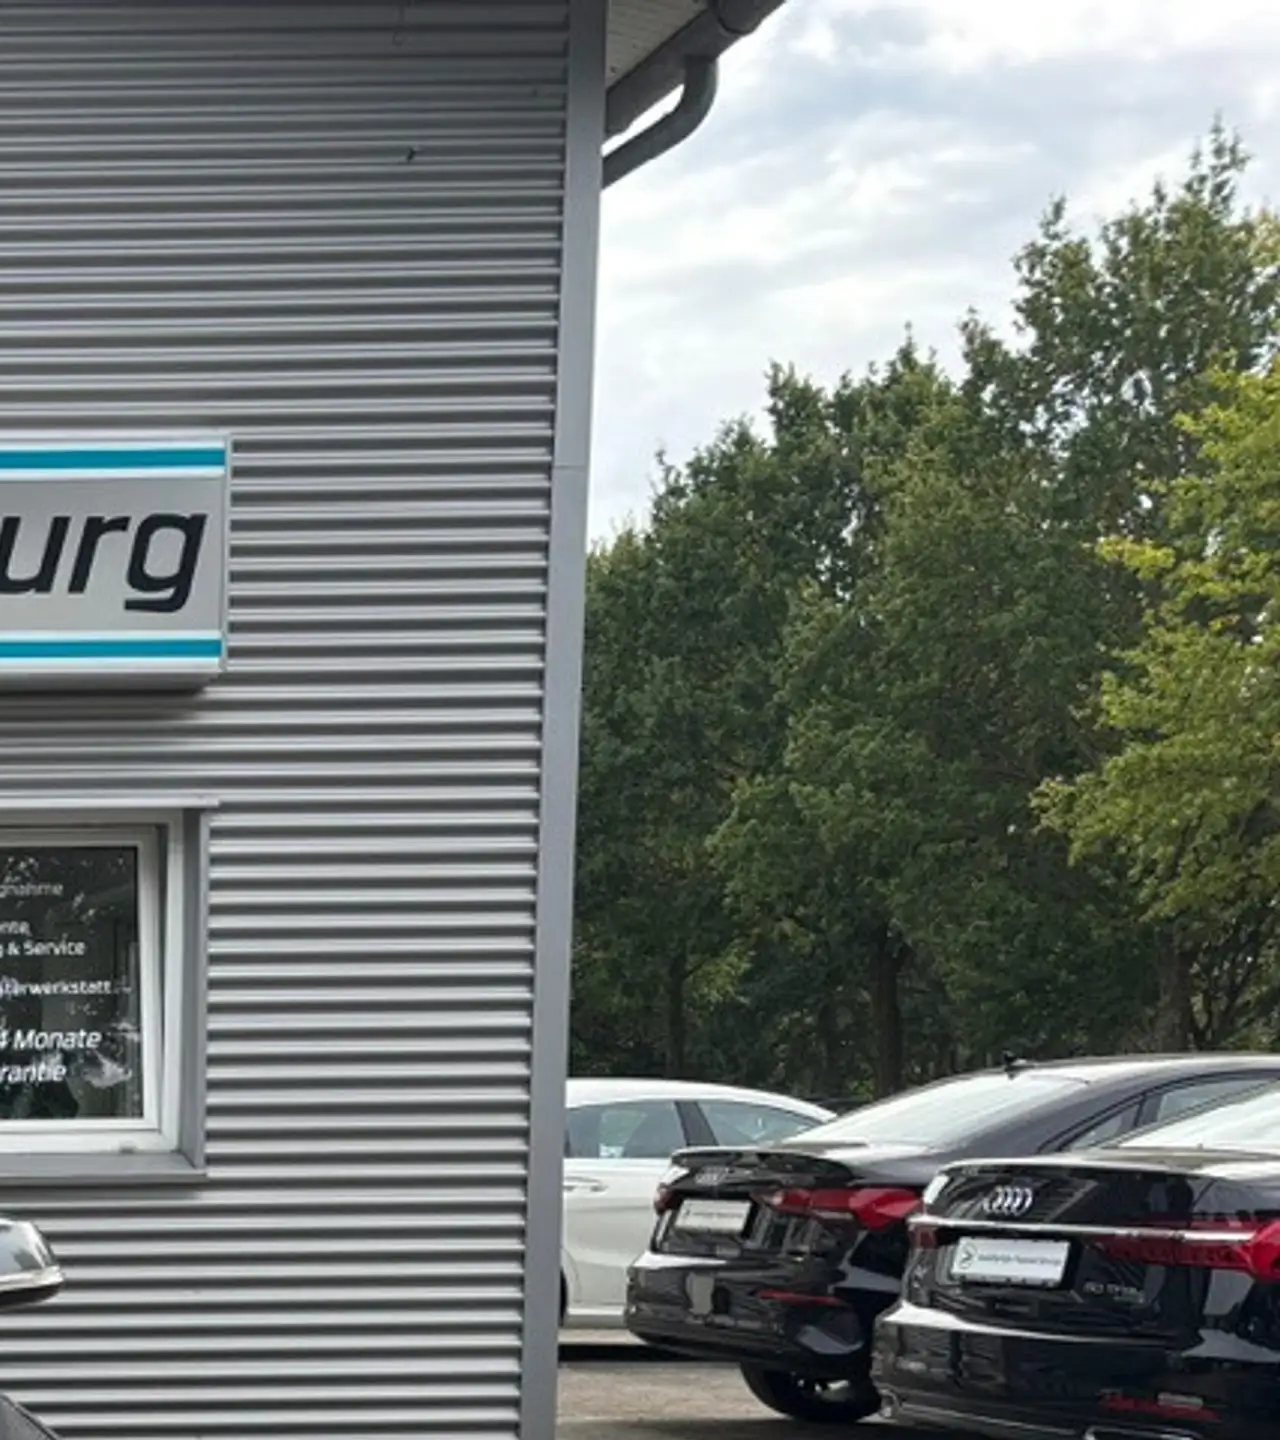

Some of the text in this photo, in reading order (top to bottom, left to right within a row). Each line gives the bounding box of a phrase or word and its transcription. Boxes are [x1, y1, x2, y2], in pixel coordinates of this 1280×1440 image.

[7, 941, 21, 956] &
[23, 938, 86, 956] Service
[13, 1028, 102, 1050] Monate
